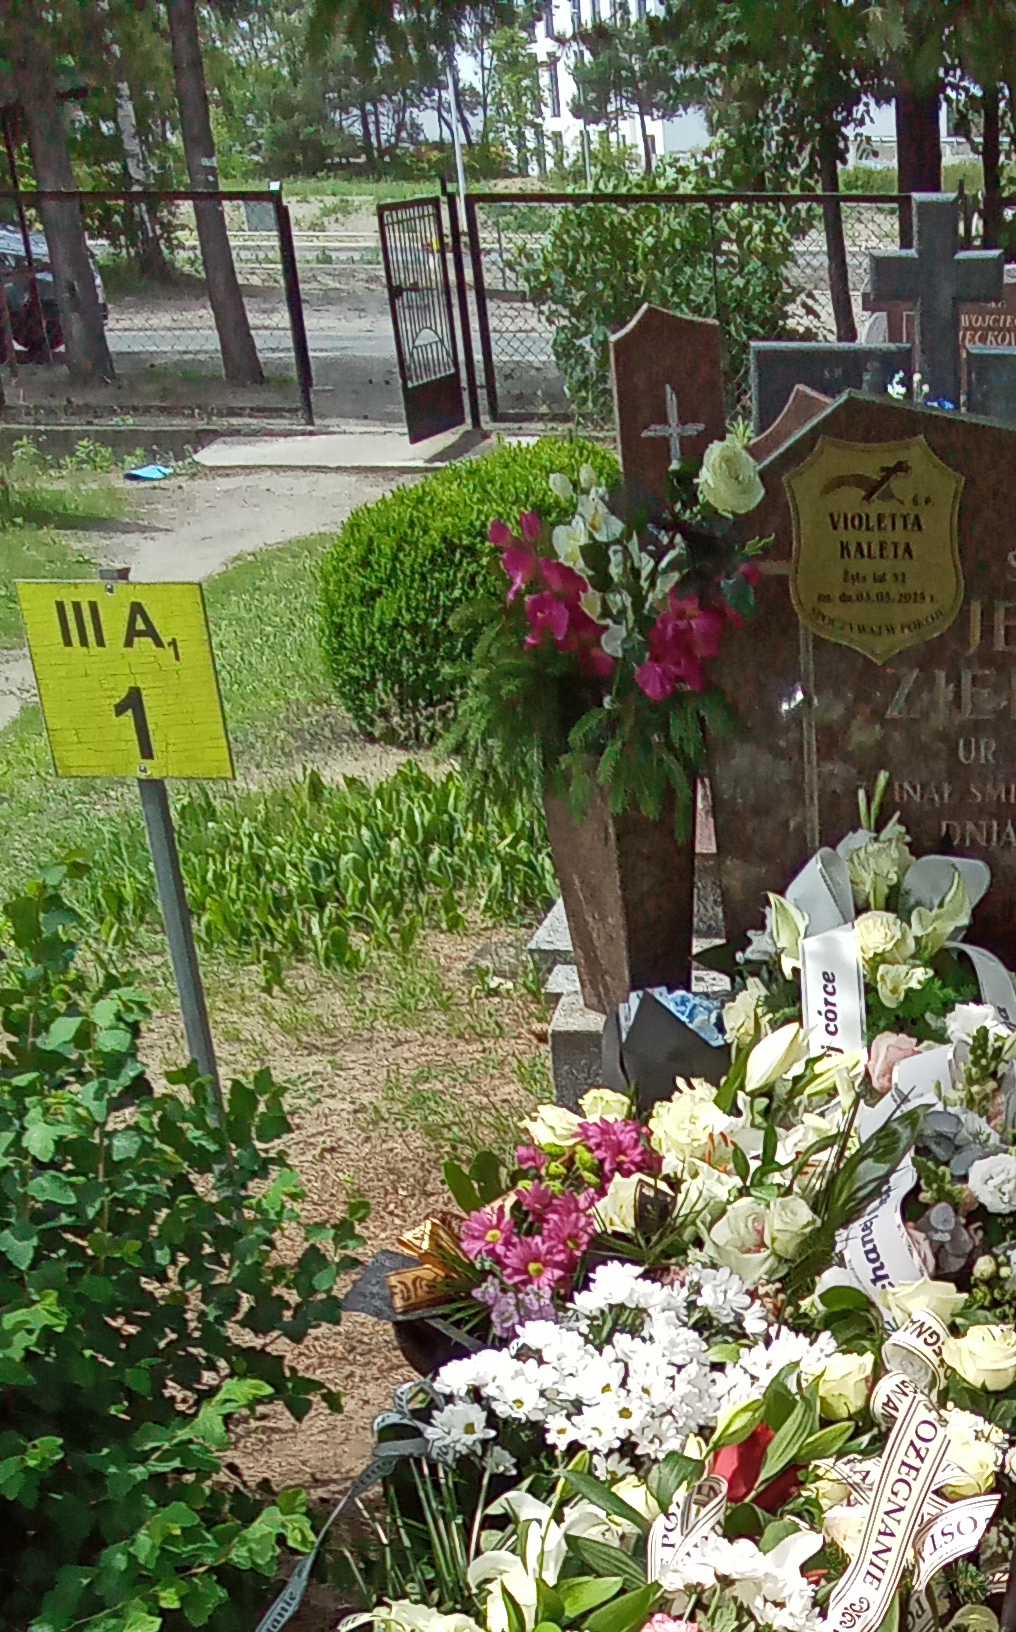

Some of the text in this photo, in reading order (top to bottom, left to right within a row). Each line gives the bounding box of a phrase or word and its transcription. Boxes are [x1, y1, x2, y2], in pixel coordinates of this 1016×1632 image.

[829, 512, 923, 533] VIOLETTA
[839, 540, 914, 560] KALETA
[55, 600, 106, 648] III
[114, 686, 154, 760] 1
